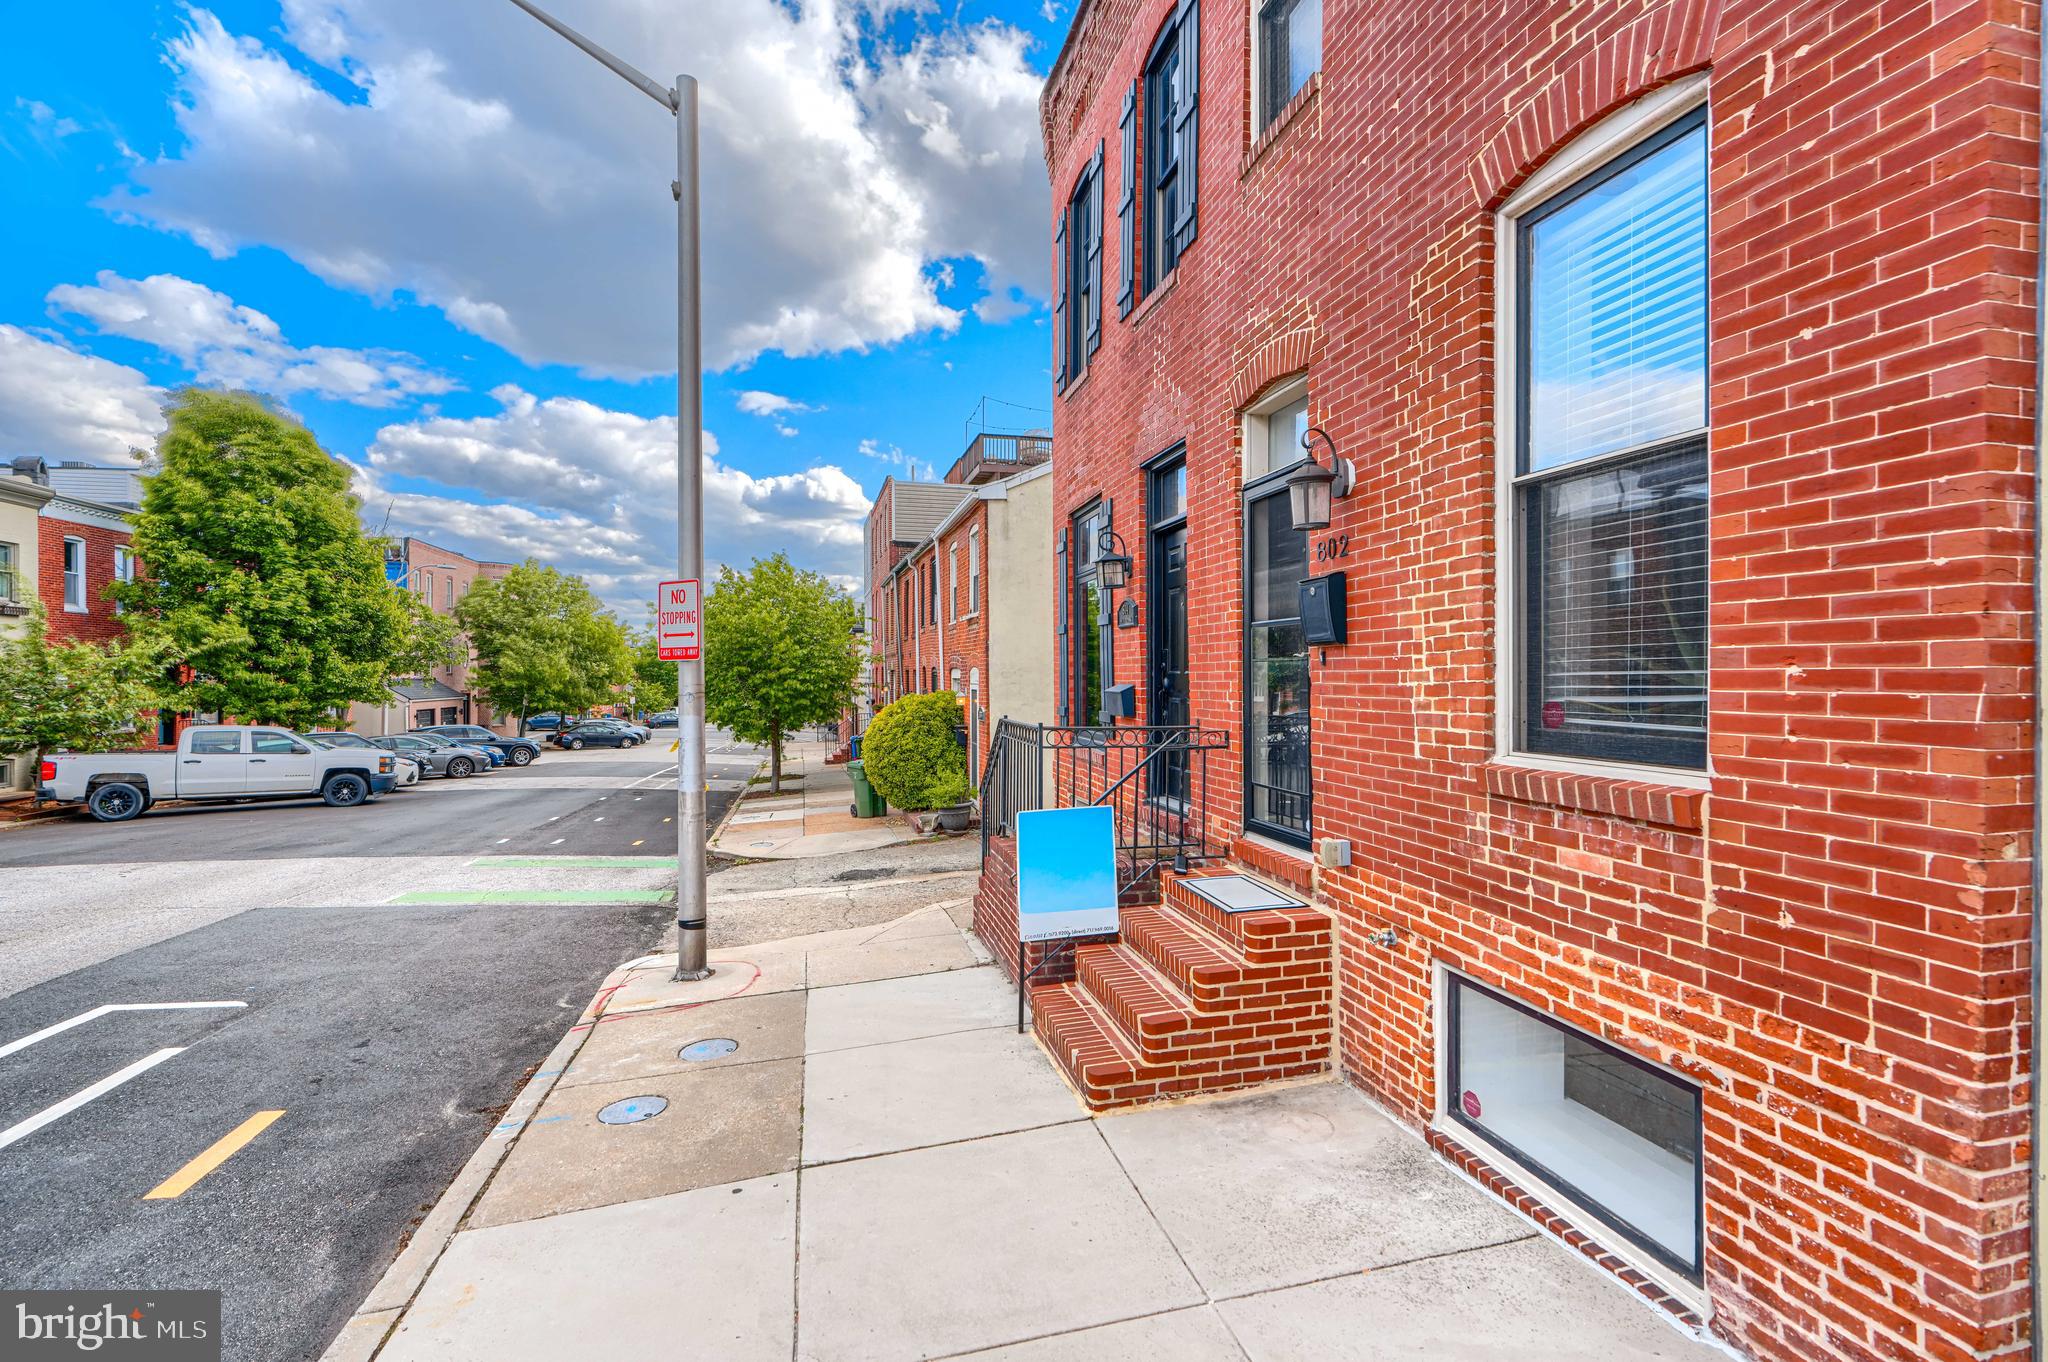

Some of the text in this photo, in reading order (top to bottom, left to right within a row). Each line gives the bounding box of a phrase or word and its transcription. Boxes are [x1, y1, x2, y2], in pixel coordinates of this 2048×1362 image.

[1317, 534, 1349, 562] 802
[671, 588, 687, 605] NO
[661, 610, 696, 625] STOPPING
[660, 648, 671, 657] CARS
